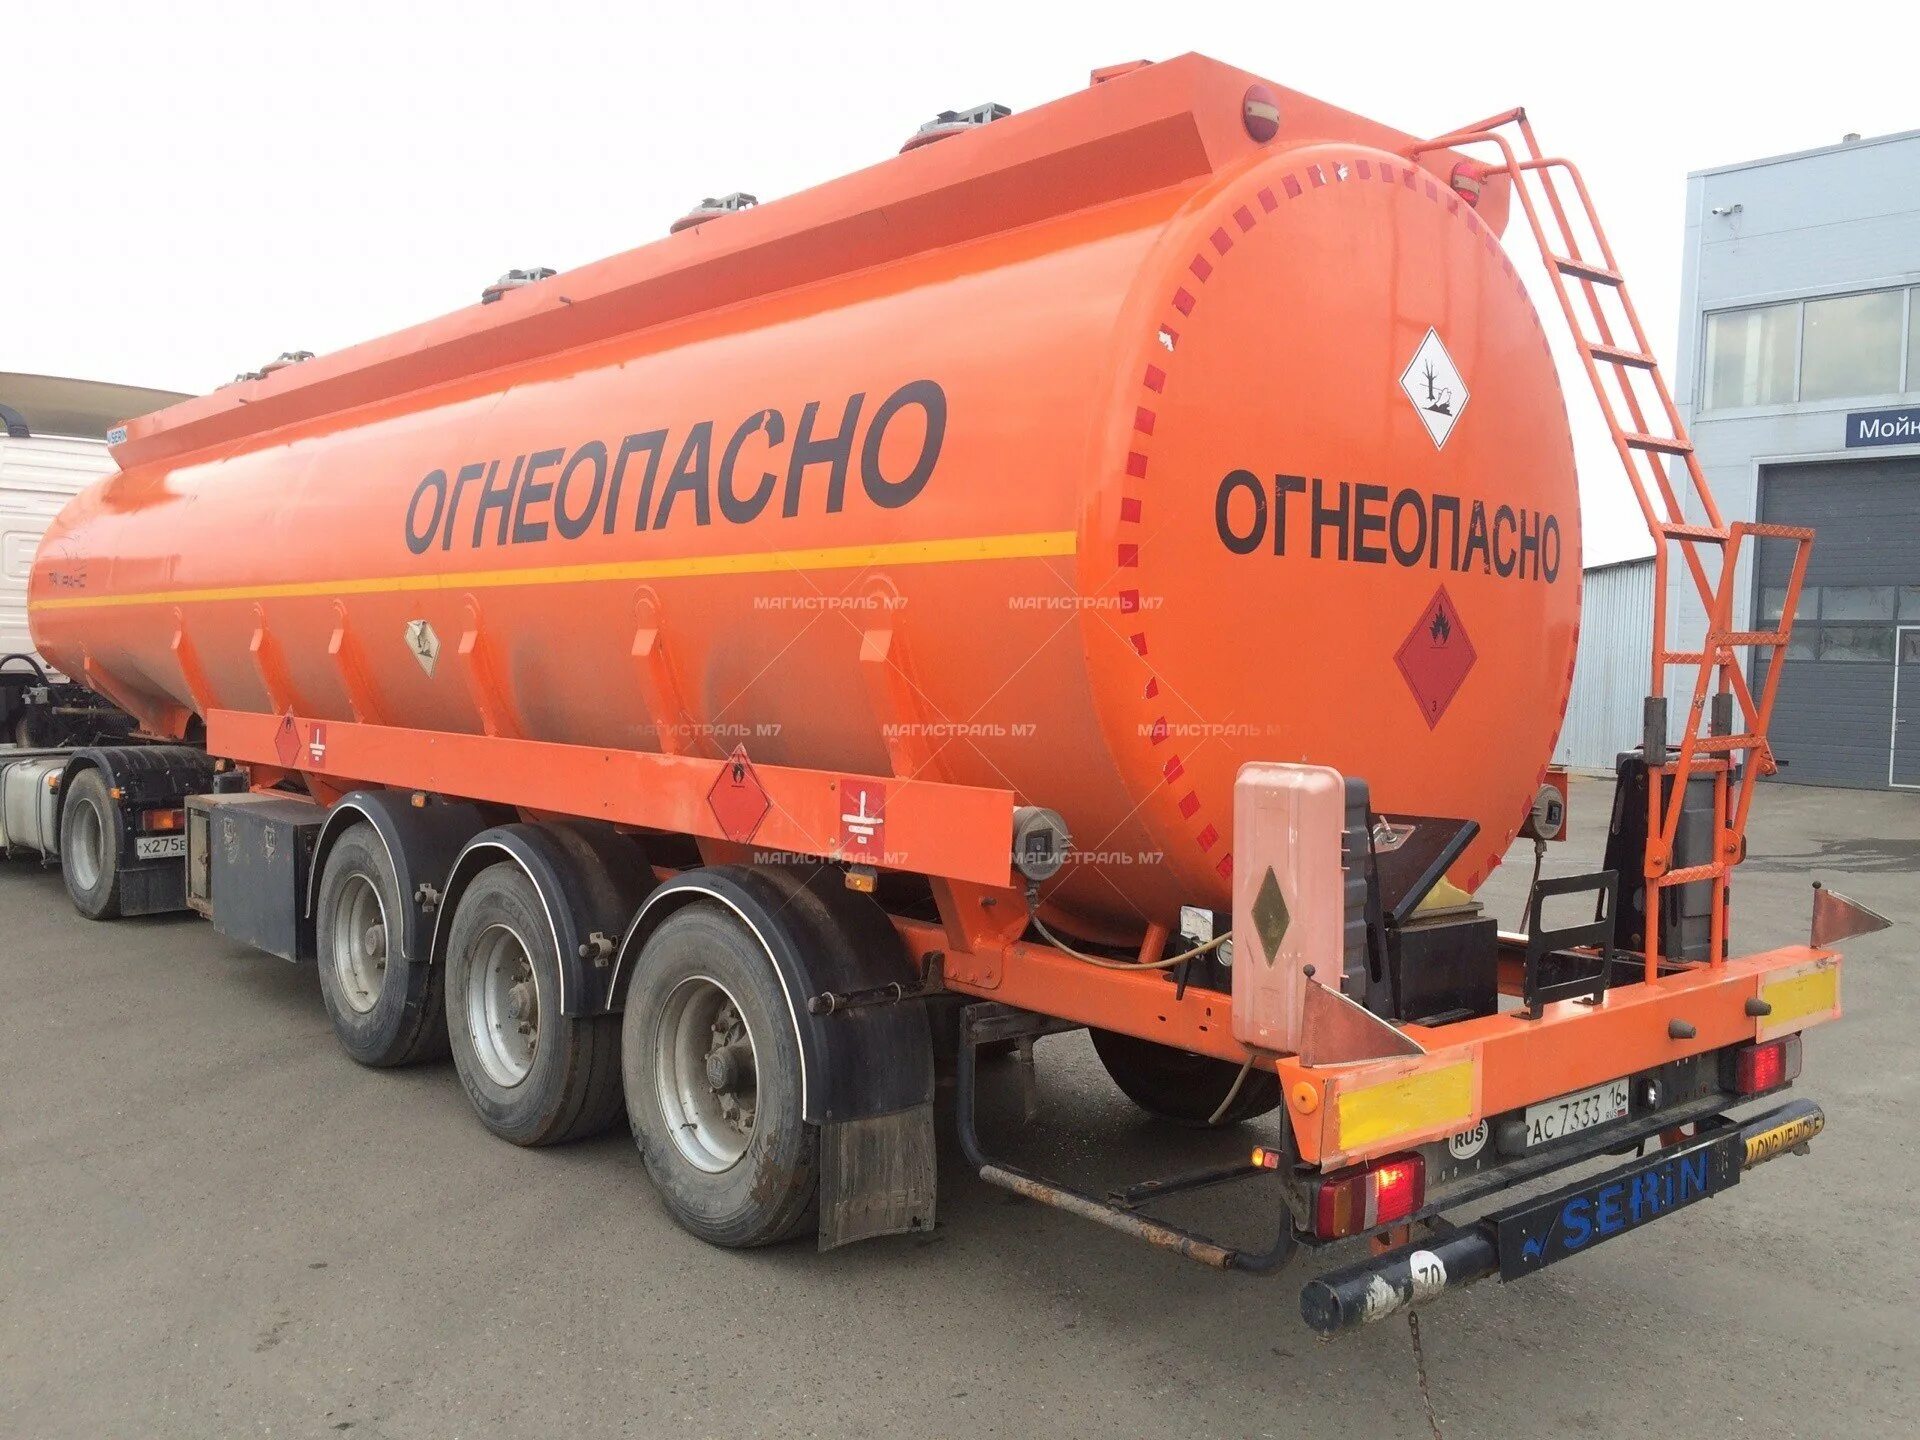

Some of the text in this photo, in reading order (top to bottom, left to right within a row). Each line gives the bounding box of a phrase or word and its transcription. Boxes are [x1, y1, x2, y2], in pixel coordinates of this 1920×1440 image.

[405, 379, 948, 555] ОГНЕОПАСНО
[1215, 469, 1561, 584] ОГНЕОПАСНО
[1454, 1125, 1485, 1150] RUS
[1750, 1134, 1778, 1161] LONG
